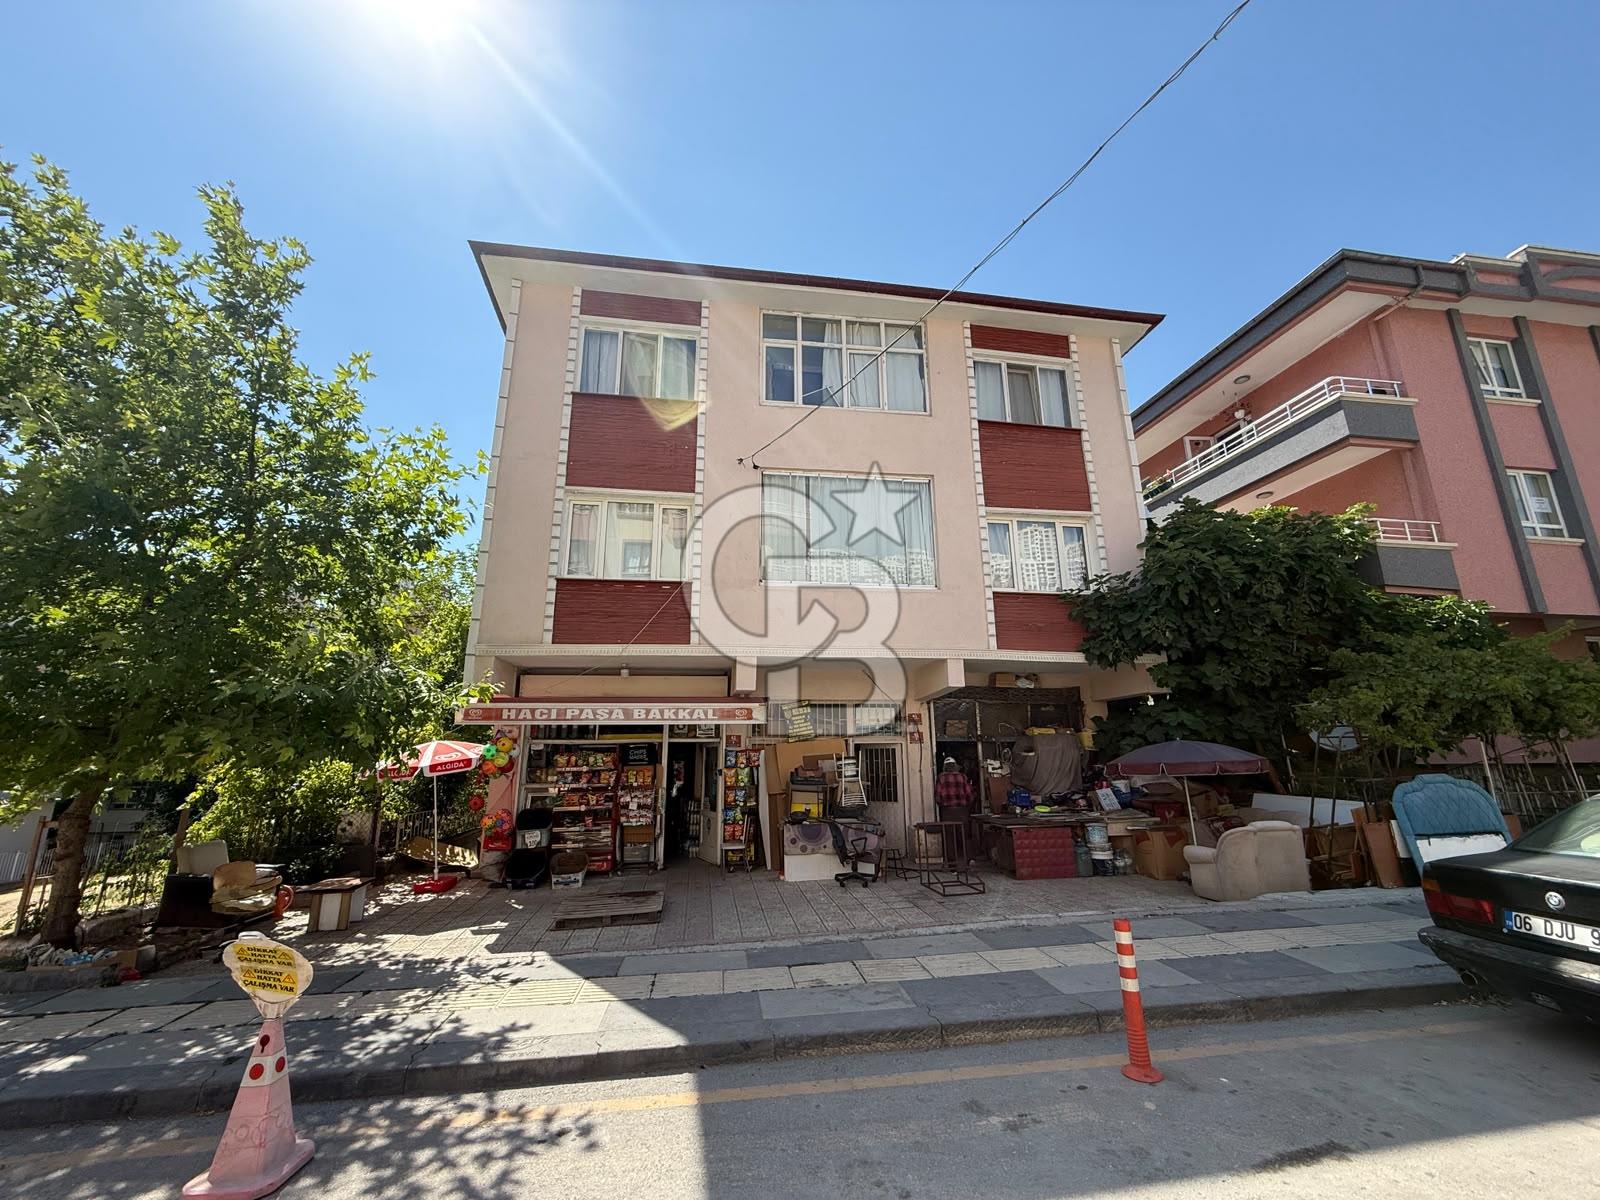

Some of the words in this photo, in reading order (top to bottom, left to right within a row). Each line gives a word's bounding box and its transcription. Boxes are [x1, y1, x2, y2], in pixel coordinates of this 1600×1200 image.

[502, 708, 558, 720] HACI
[566, 708, 625, 721] PAŞA
[633, 708, 718, 720] BAKKAL
[436, 761, 464, 771] ALGIDA
[1513, 913, 1532, 932] 06
[1544, 919, 1576, 941] DJU
[1590, 928, 1600, 946] 9
[247, 946, 277, 954] DİKKAT
[237, 956, 275, 965] ÇALIŞMA
[254, 968, 283, 976] DİKKAT
[257, 975, 282, 983] HATTA
[243, 979, 277, 990] ÇALIŞMA
